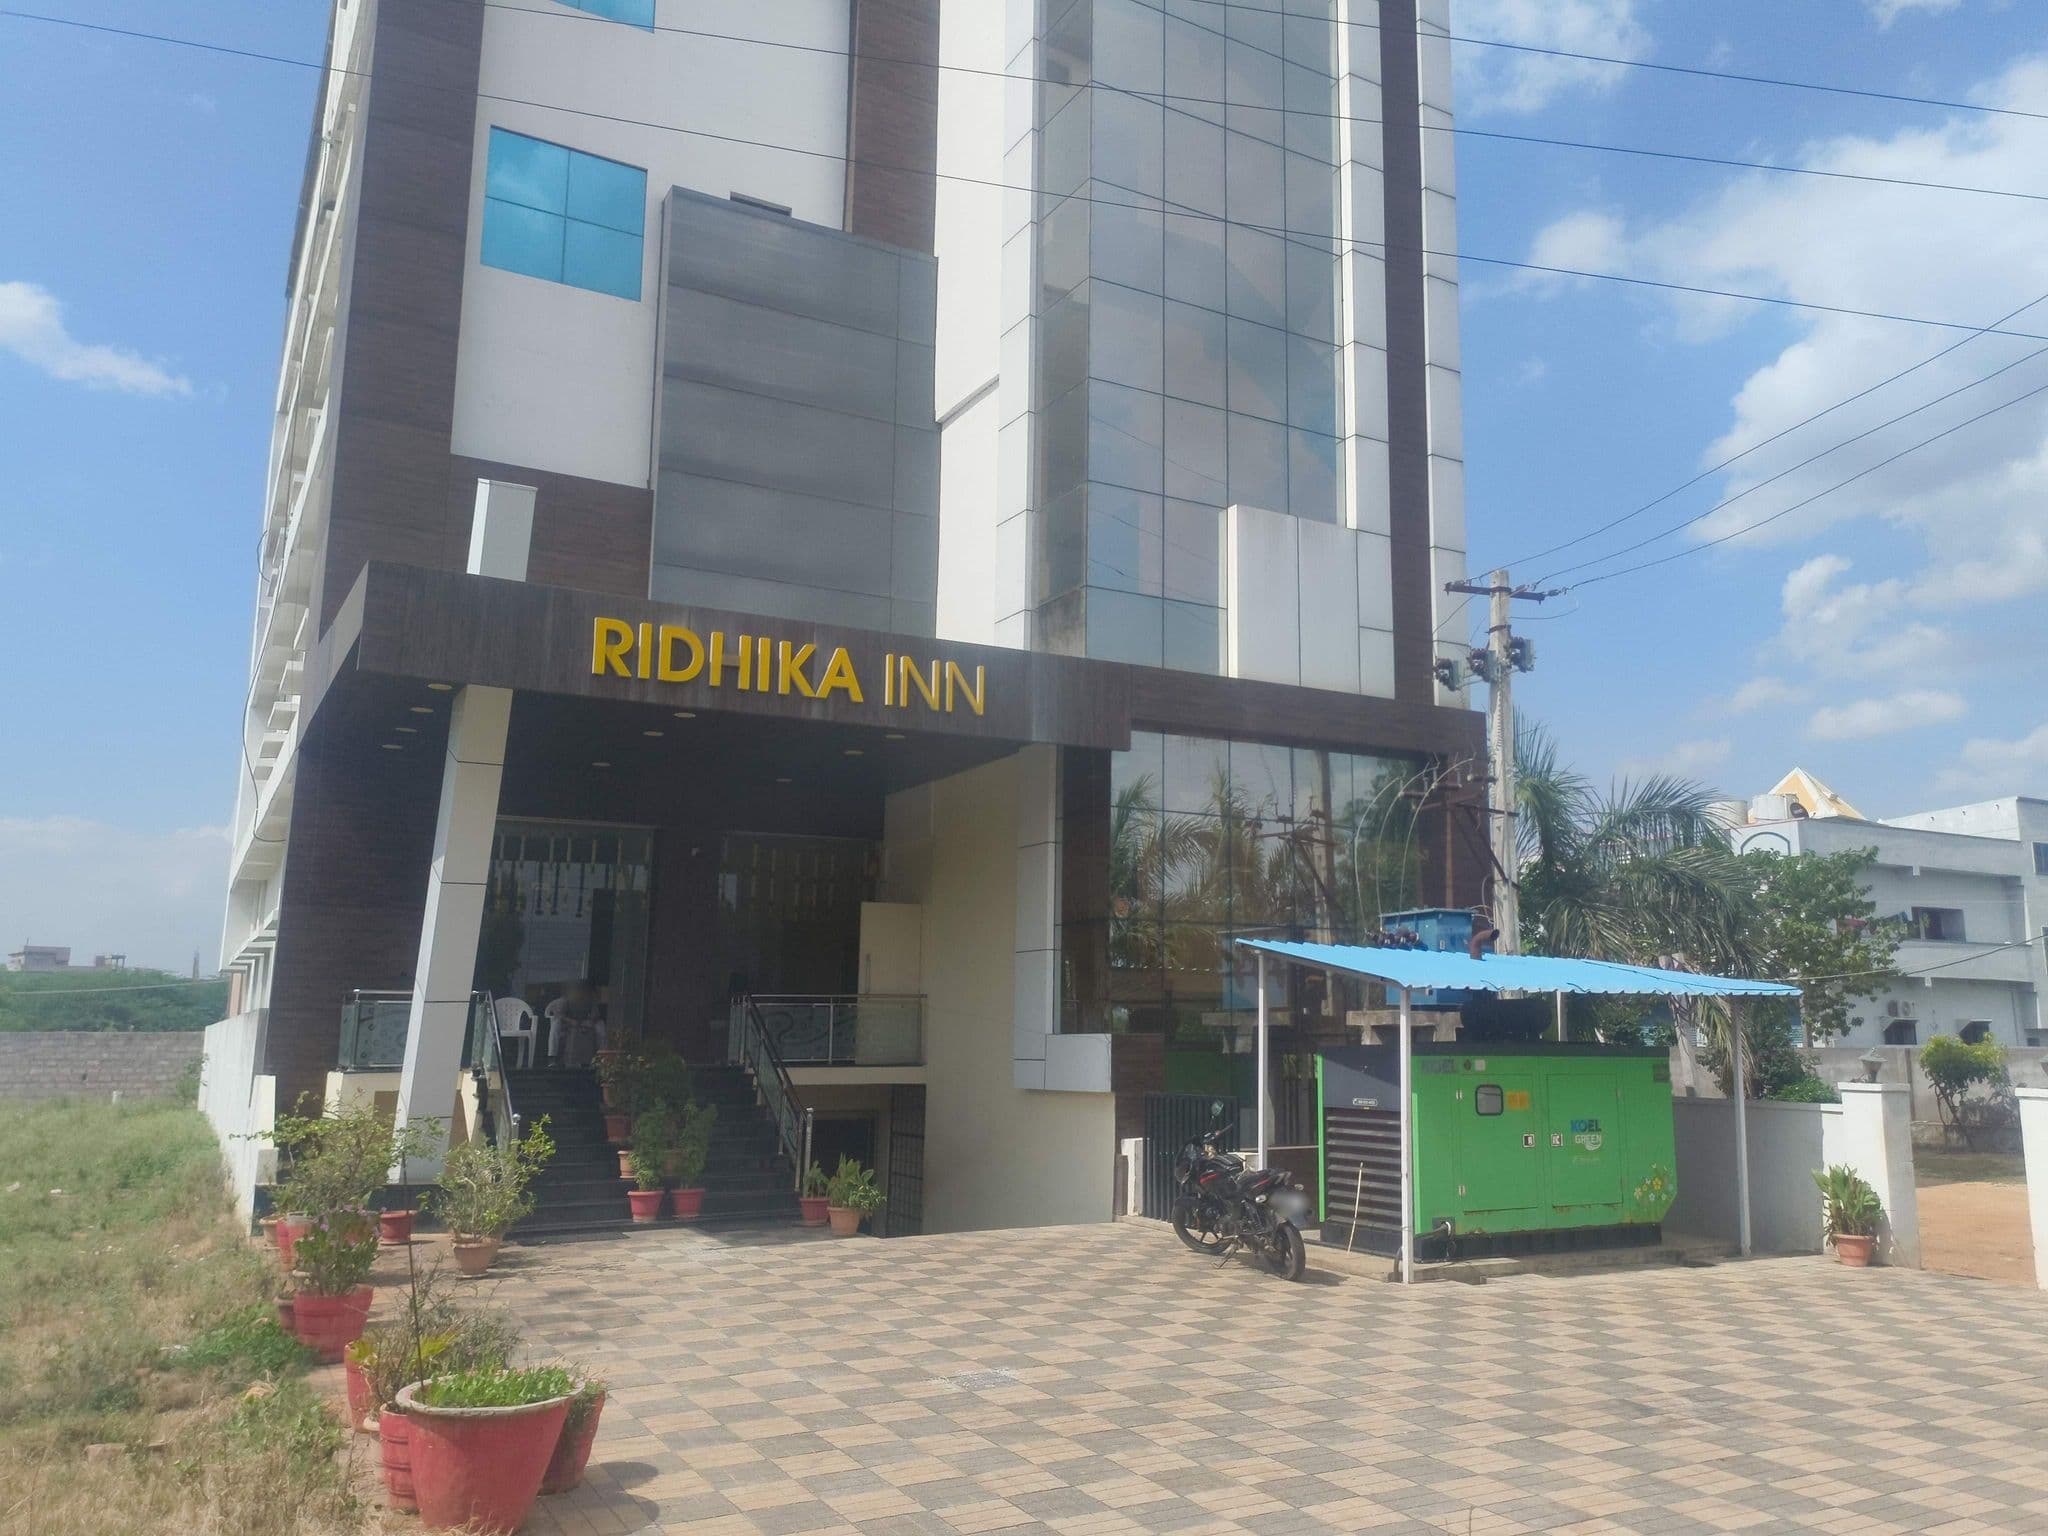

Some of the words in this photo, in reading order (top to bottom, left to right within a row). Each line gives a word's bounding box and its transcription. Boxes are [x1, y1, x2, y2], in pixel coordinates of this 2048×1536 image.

[591, 616, 864, 703] RIDHIKA
[885, 653, 985, 716] INN
[1570, 1119, 1602, 1132] KOEL
